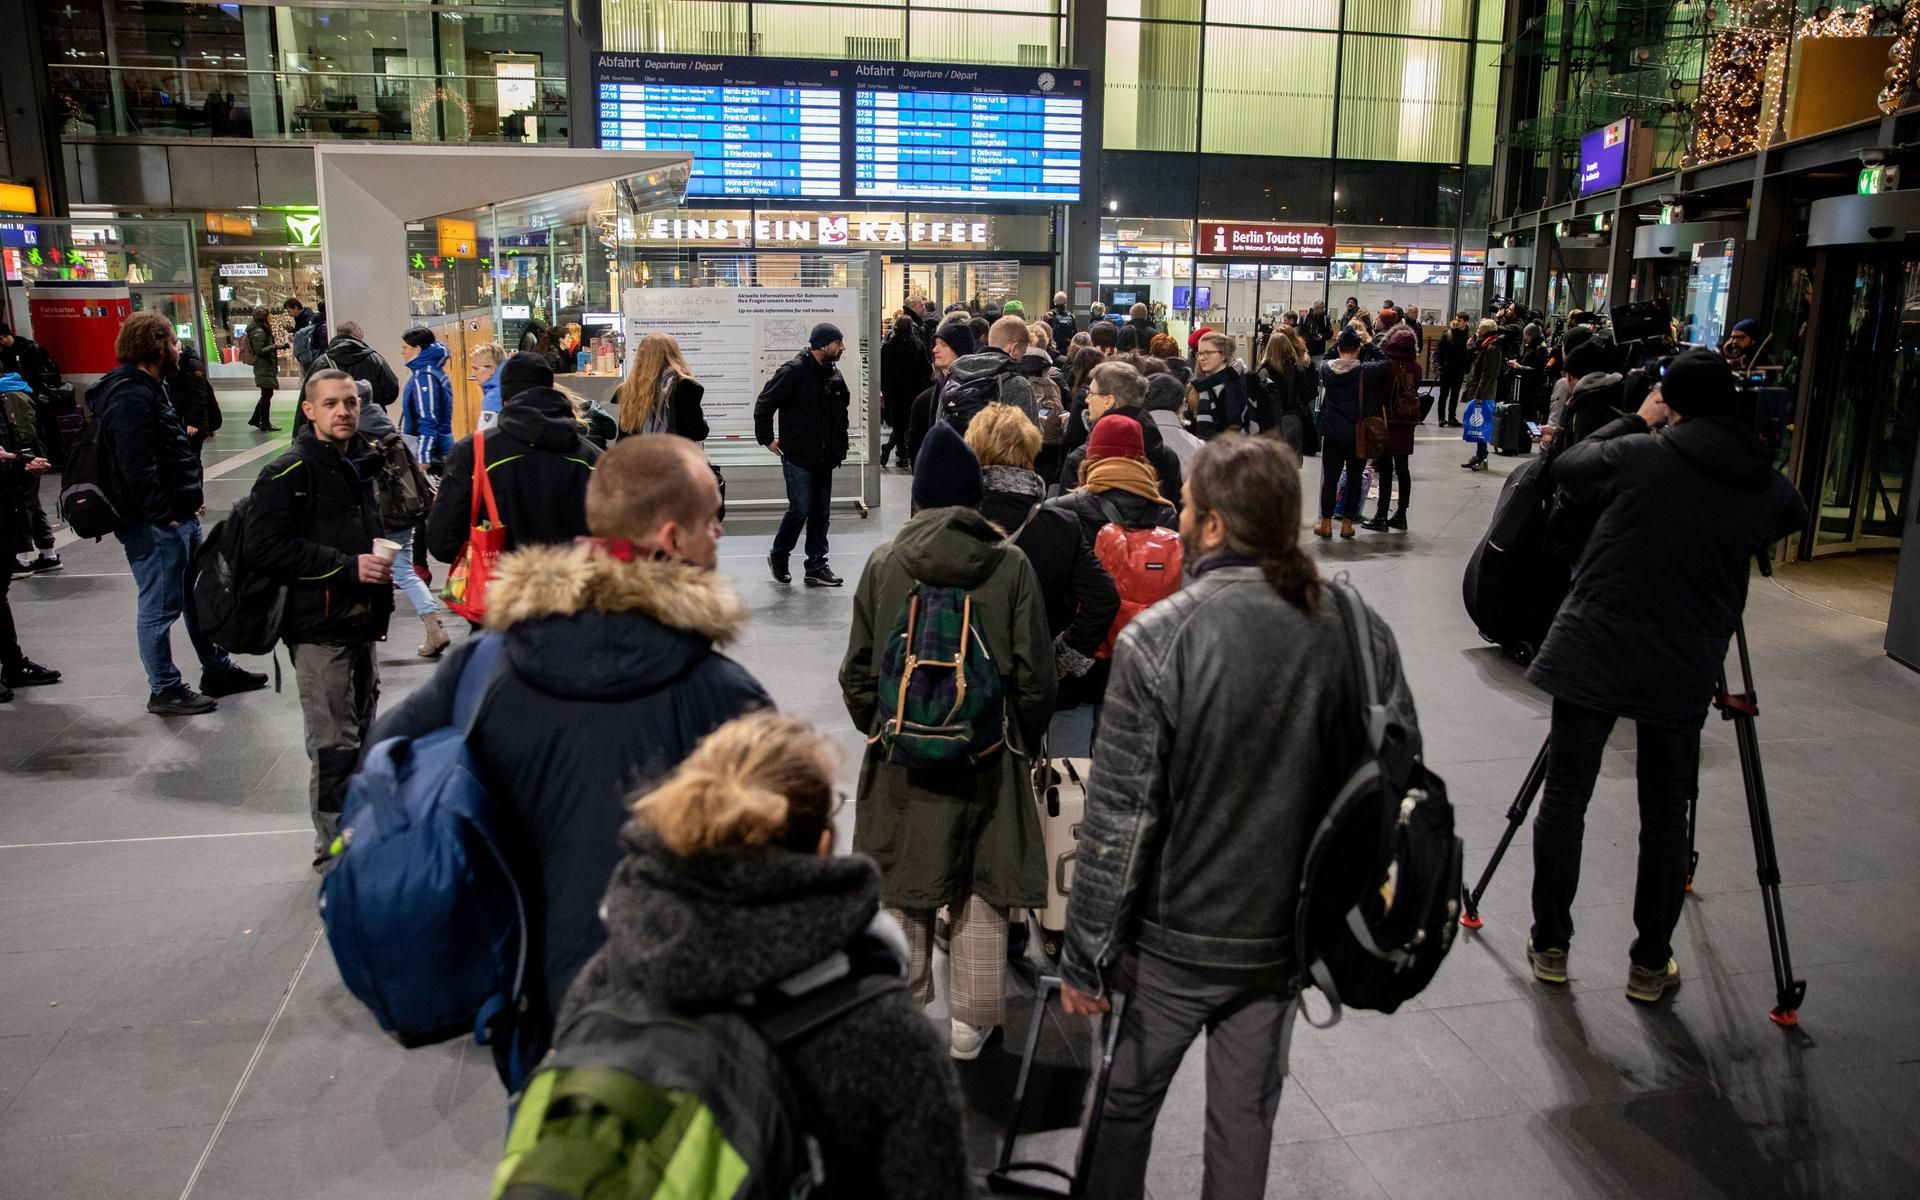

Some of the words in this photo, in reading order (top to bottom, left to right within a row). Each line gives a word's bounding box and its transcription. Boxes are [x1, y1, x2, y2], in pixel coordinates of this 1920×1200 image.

[598, 56, 640, 69] Abfahrt
[644, 60, 687, 71] Departure
[855, 64, 895, 77] Abfahrt
[902, 69, 944, 79] Departure
[653, 218, 810, 240] EINSTEIN
[860, 222, 986, 242] KAFFEE
[1233, 231, 1263, 243] Berlin
[1266, 232, 1301, 244] Tourist
[1304, 233, 1324, 245] Info
